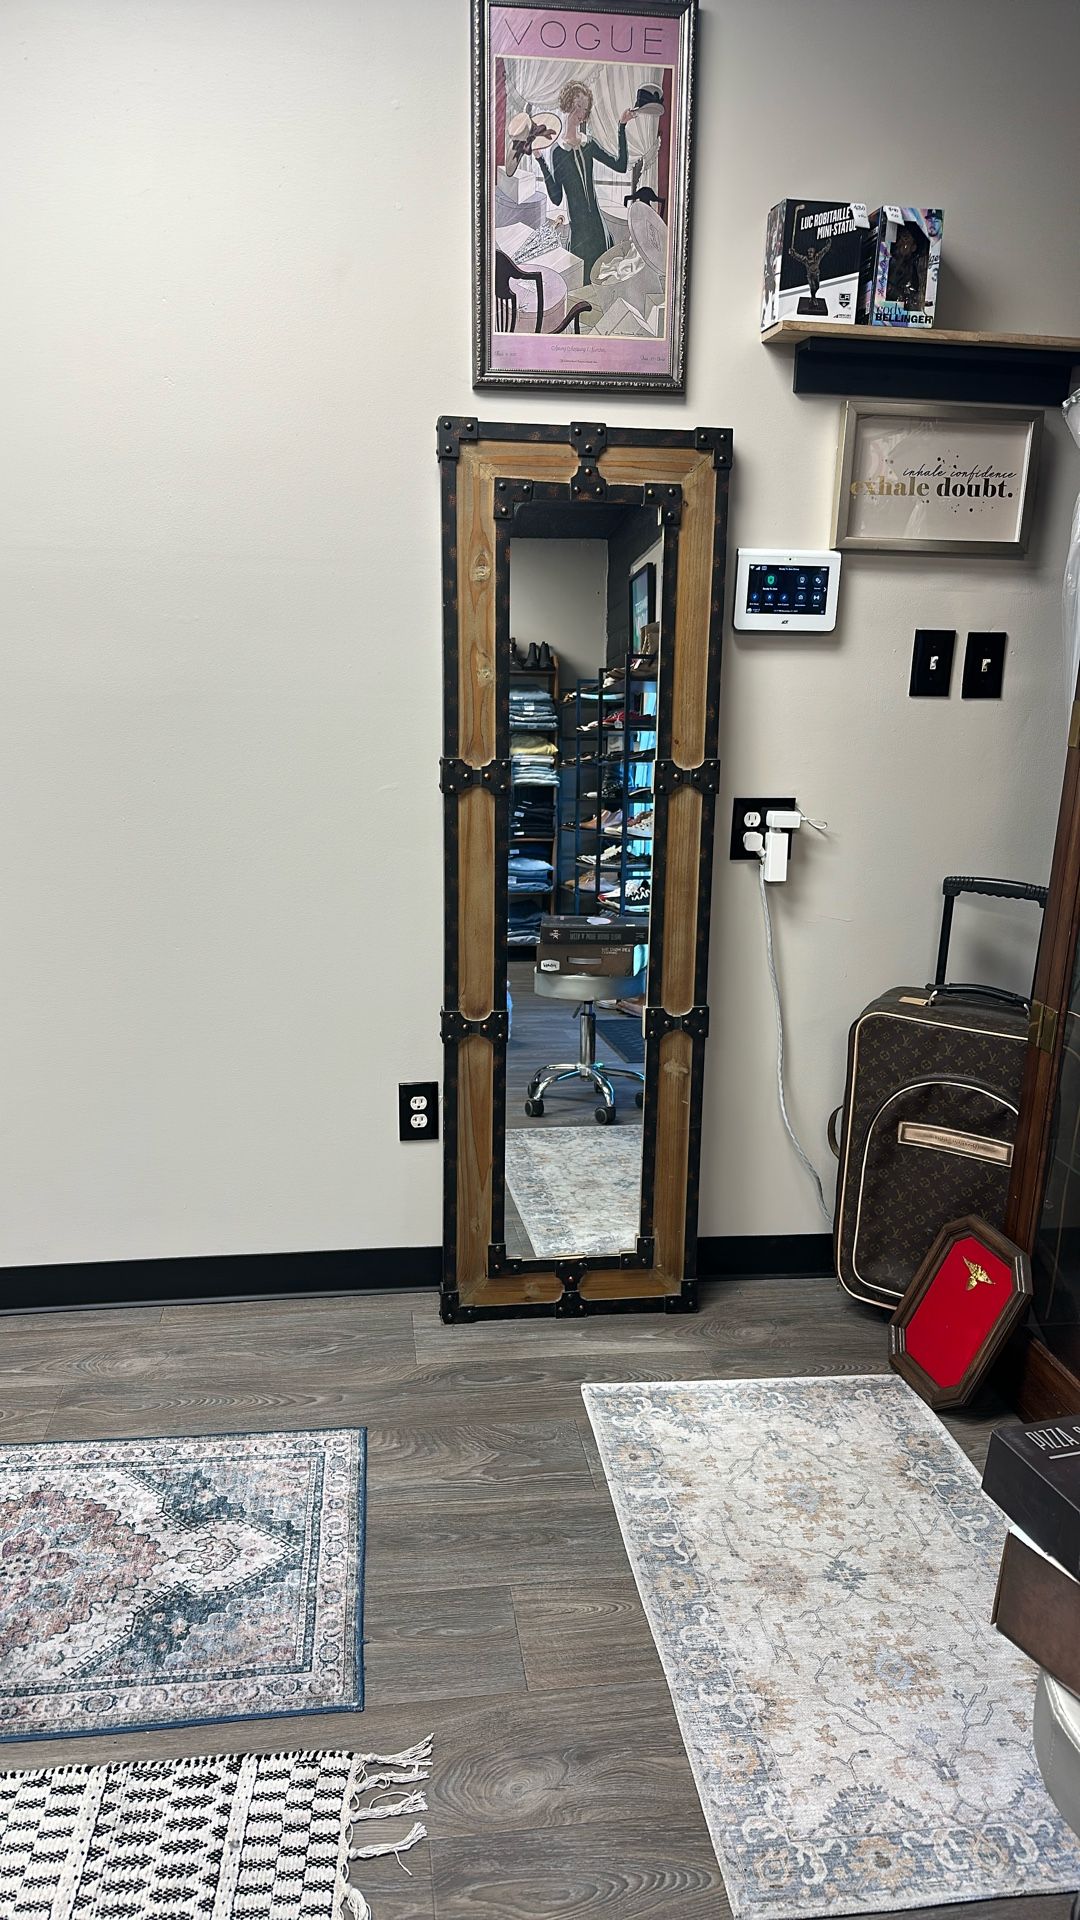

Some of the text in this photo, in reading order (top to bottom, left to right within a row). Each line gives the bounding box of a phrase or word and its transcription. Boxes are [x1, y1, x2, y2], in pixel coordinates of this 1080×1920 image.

[504, 18, 663, 55] VOGUE
[800, 214, 814, 231] LUC
[813, 206, 852, 228] ROBITAILLE
[875, 313, 934, 324] BELLINGER
[903, 464, 1017, 485] inhale confidence
[850, 476, 1014, 498] exhale doubt.
[1024, 1427, 1080, 1451] PIZZA
